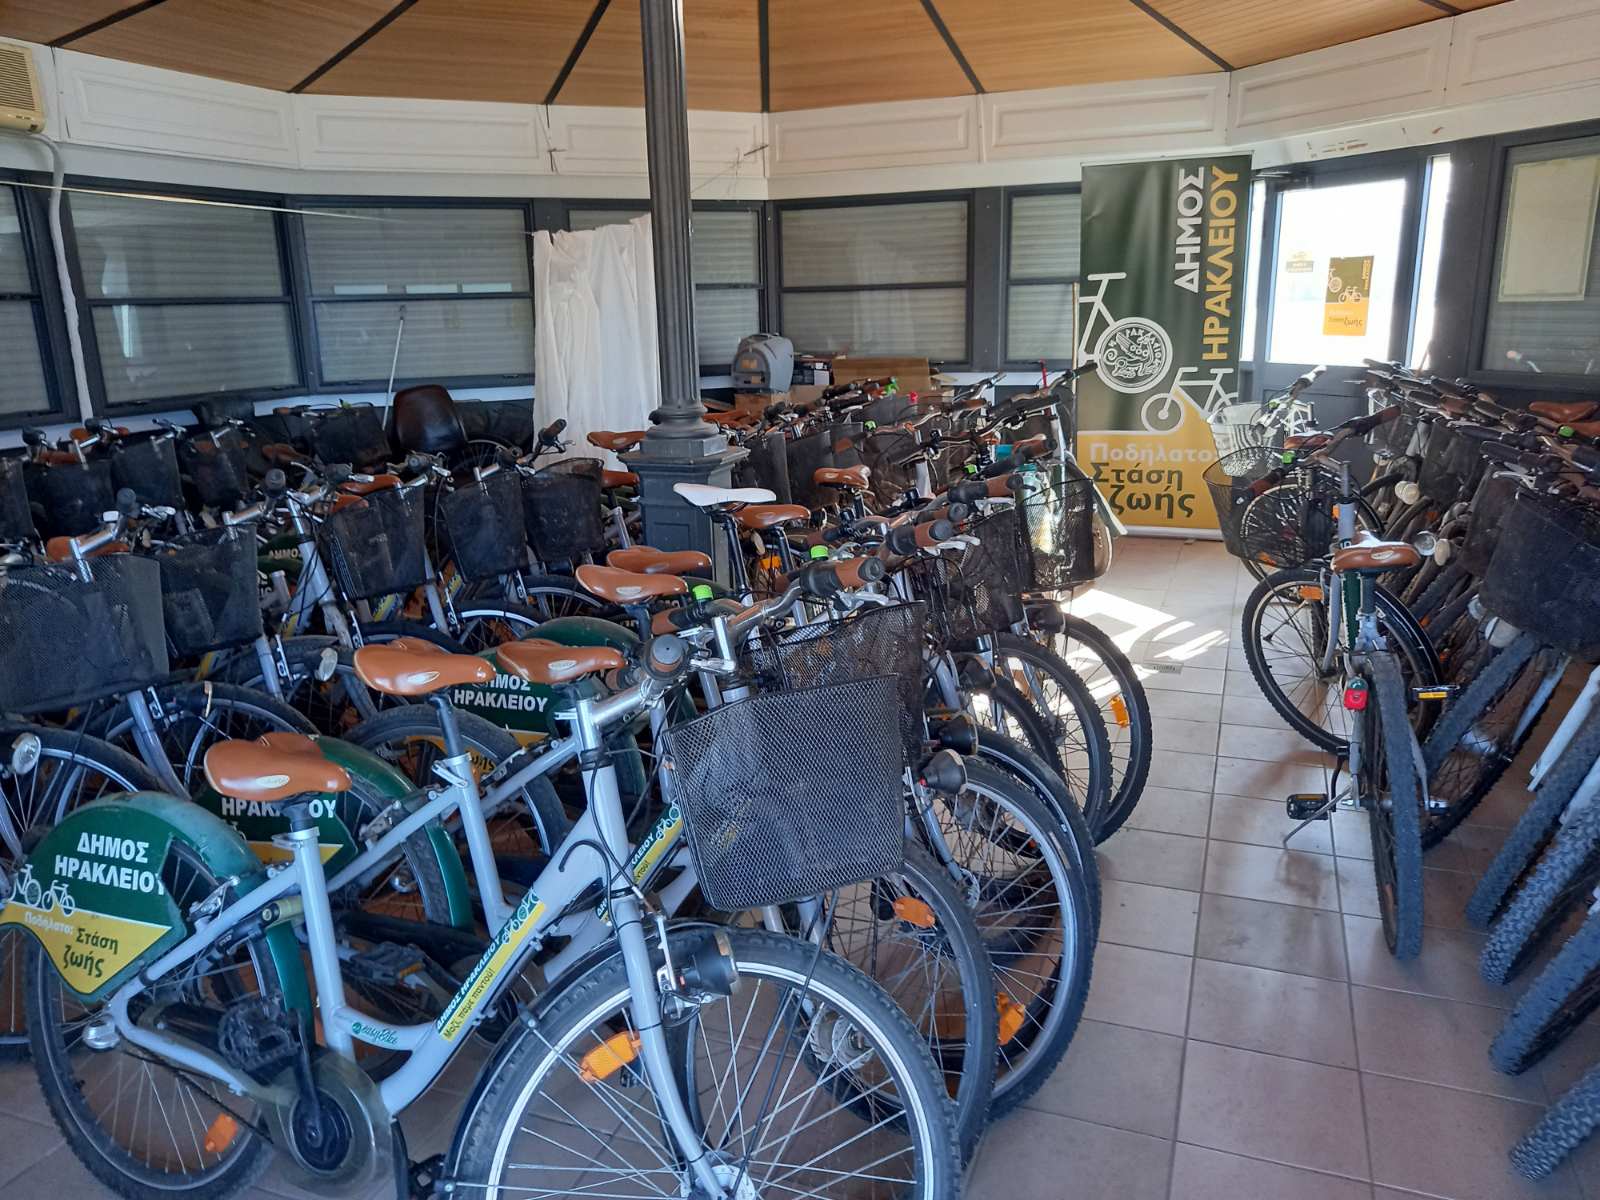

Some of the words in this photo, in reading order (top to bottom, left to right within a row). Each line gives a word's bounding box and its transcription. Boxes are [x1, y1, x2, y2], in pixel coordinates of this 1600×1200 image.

[1174, 166, 1205, 293] ΔΗΜΟΣ
[1202, 165, 1239, 360] ΗΡΑΚΛΕΙΟΥ
[1090, 462, 1183, 491] Στάση
[1109, 484, 1196, 519] ζωής
[454, 689, 548, 712] ΗΡΑΚΛΕΙΟΥ
[221, 798, 336, 818] ΗΡΑΚΟΥ
[77, 832, 149, 863] ΔΗΜΟΣ
[54, 855, 165, 895] ΗΡΑΚΛΕΙΟΥ
[76, 927, 119, 954] Στάση
[63, 945, 104, 978] ζωής
[437, 992, 461, 1030] ΔΗΜΟΣ
[460, 935, 500, 995] ΗΡΑΚΛΕΙΟΥ
